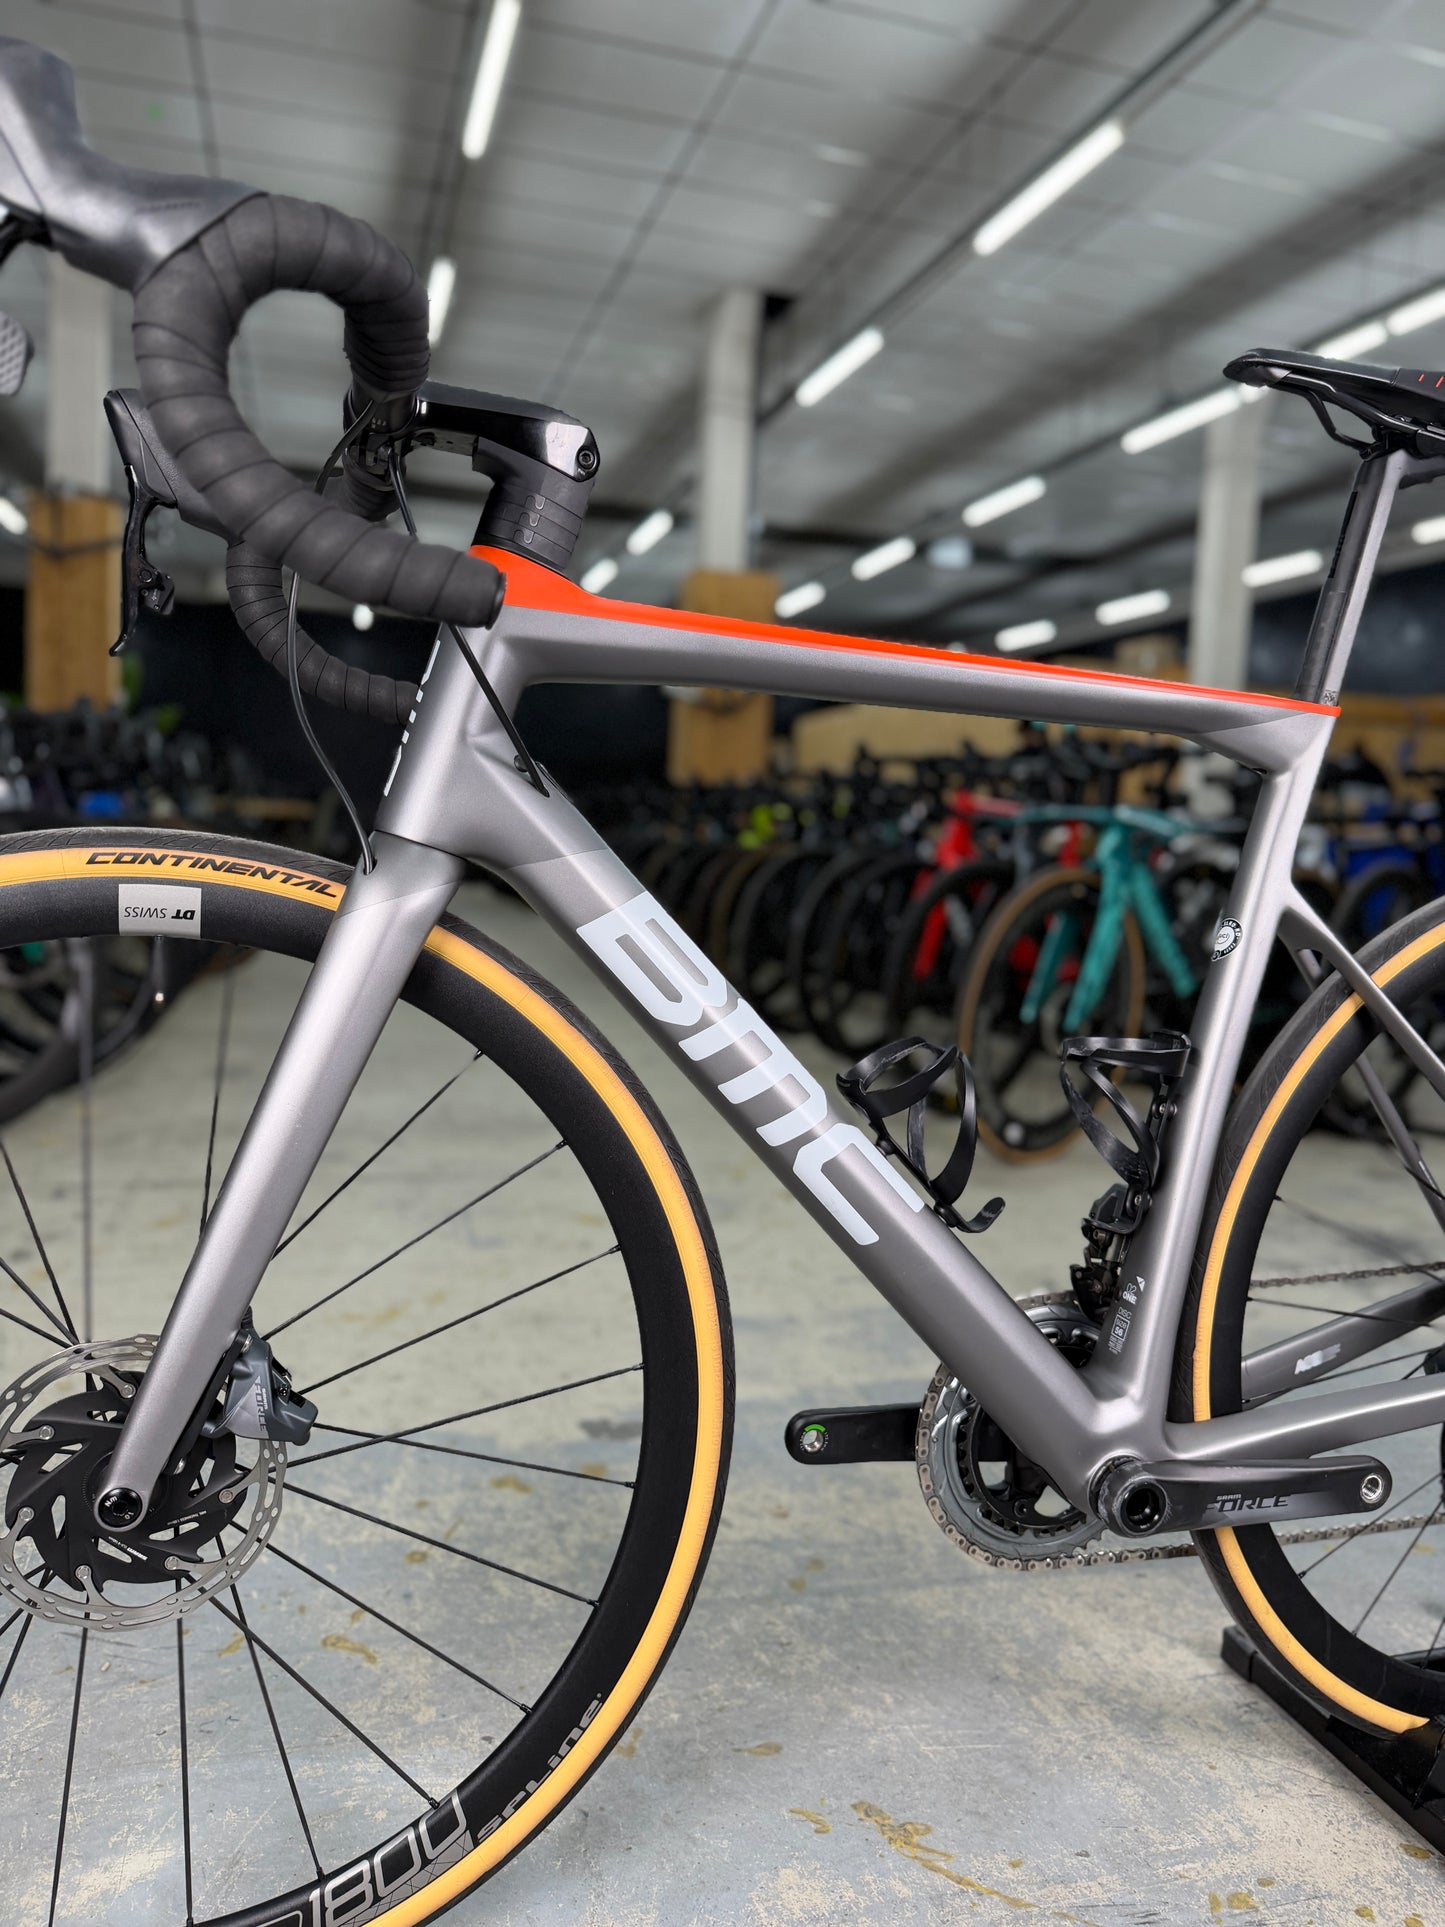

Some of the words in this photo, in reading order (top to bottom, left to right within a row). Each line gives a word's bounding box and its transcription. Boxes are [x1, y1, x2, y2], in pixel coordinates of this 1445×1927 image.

[86, 852, 336, 898] CONTINENTAL
[124, 906, 168, 919] SWISS
[171, 909, 196, 921] DT
[1122, 1290, 1138, 1305] ONE
[1117, 1306, 1133, 1319] DISC
[253, 1382, 267, 1432] FORCE
[1205, 1495, 1289, 1513] FORCE
[1216, 1493, 1242, 1501] SRAM
